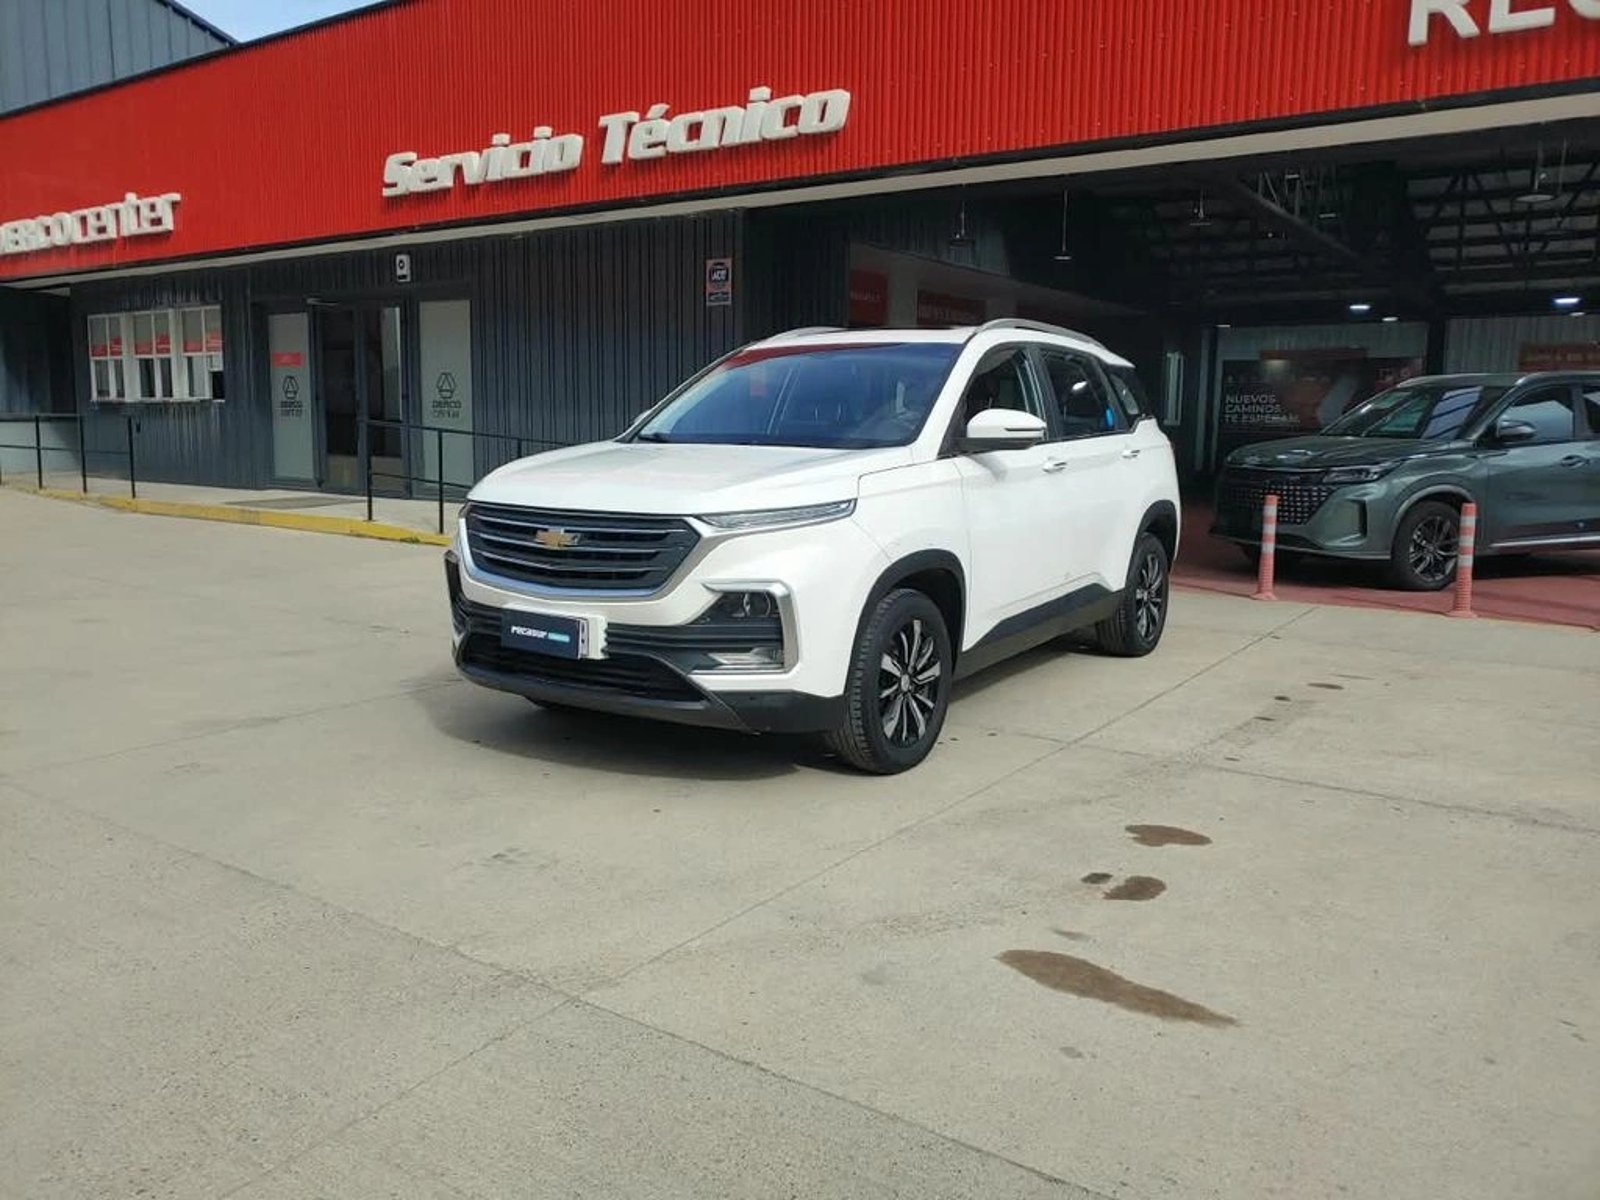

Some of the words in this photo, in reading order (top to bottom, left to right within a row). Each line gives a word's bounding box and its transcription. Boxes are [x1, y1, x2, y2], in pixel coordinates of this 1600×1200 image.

[382, 126, 583, 197] Servicio
[598, 86, 851, 164] Técnico
[0, 192, 181, 255] ercocenter
